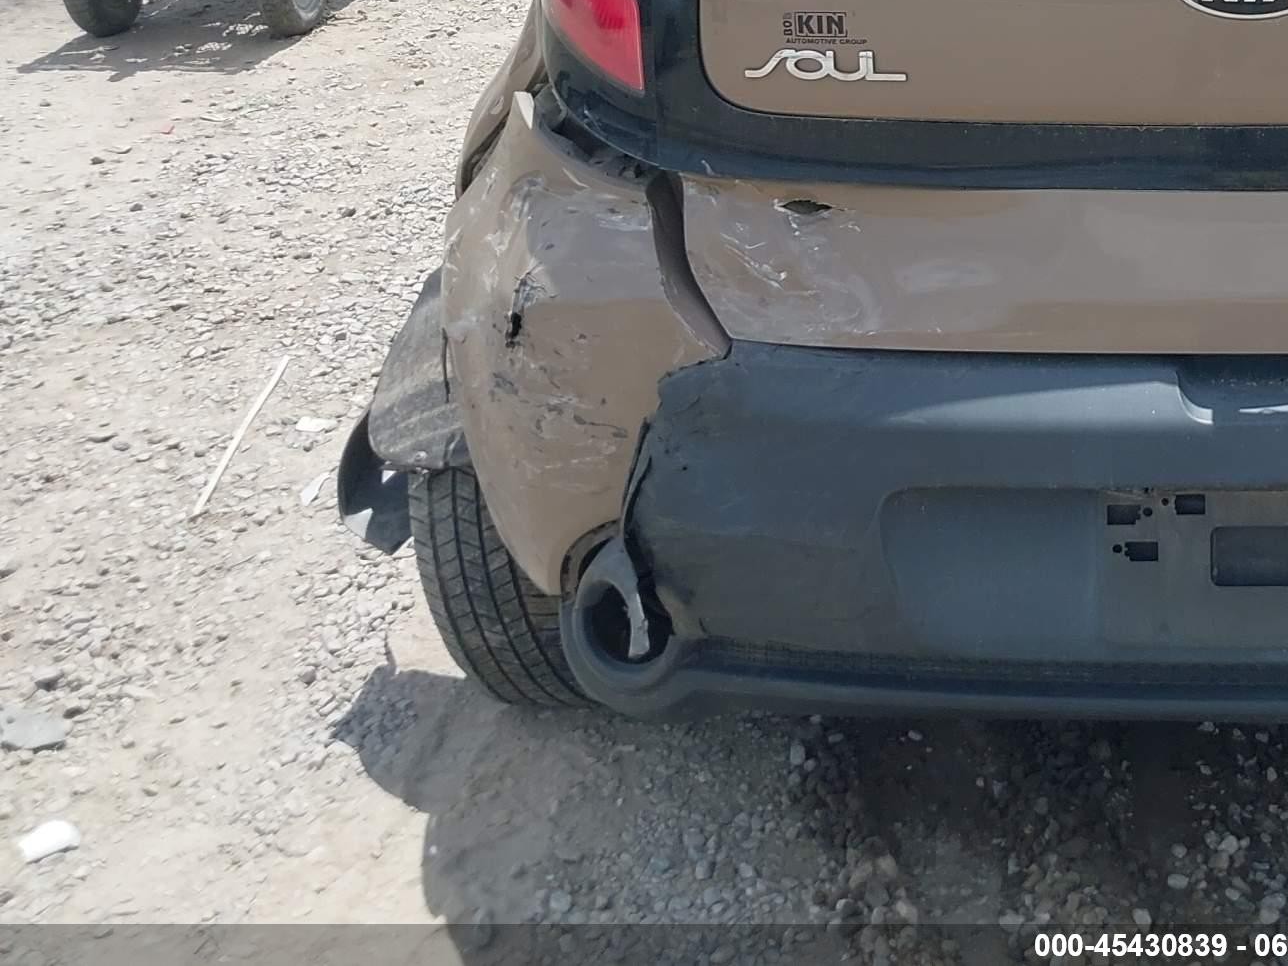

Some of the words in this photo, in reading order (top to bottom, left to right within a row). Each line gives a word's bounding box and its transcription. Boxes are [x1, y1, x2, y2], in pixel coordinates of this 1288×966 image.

[786, 37, 837, 45] AUTOMOTIVE
[839, 38, 868, 46] GROUP
[744, 48, 907, 81] SOUL
